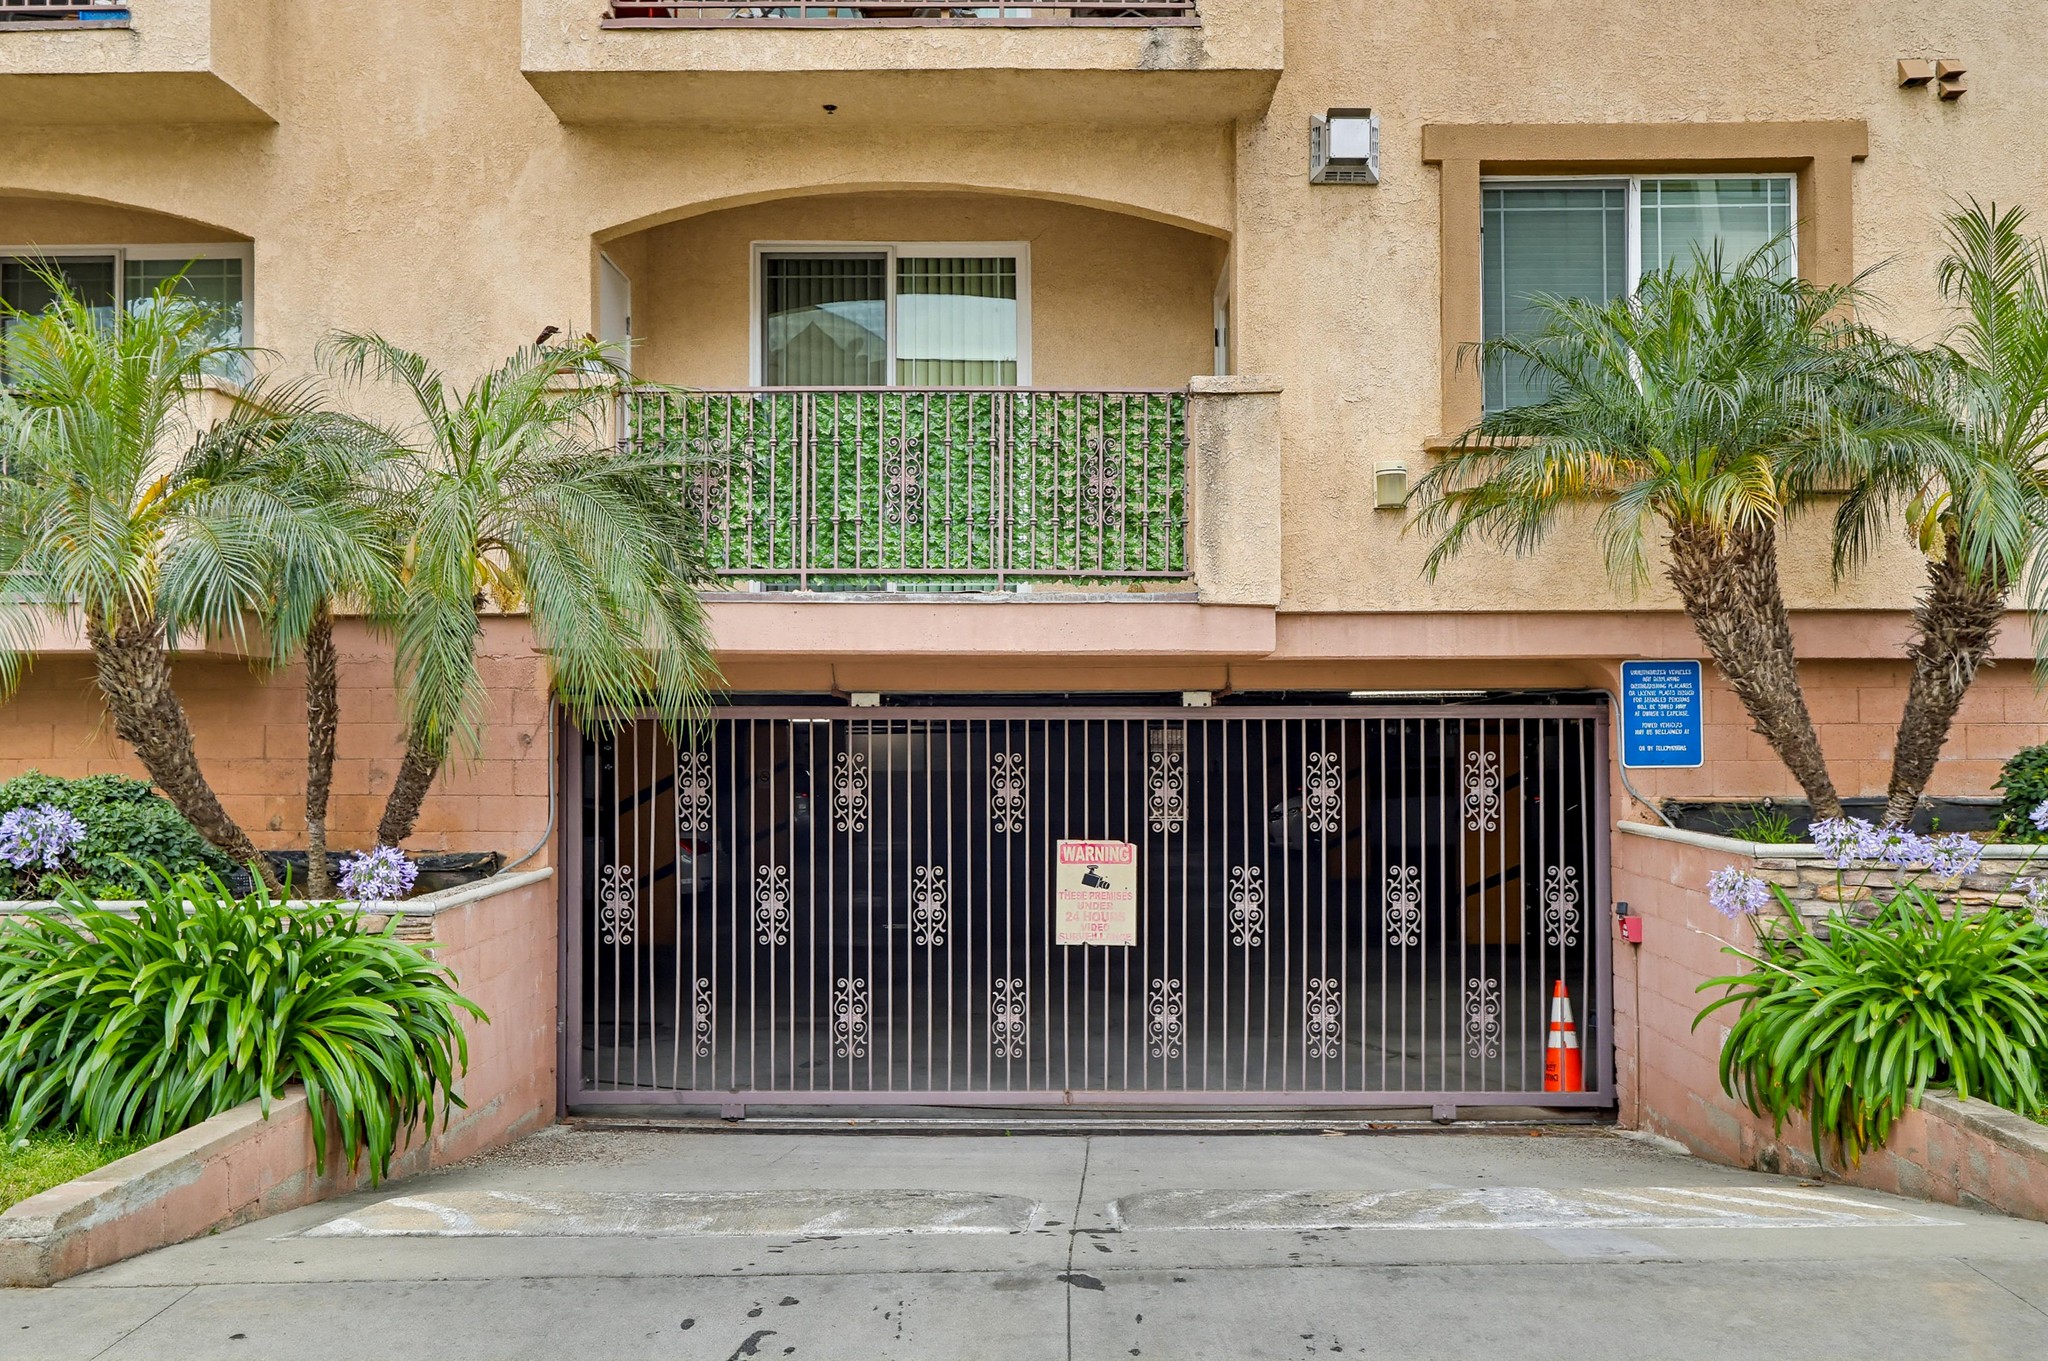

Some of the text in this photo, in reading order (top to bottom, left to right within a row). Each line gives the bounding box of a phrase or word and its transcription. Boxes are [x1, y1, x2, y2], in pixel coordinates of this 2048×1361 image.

[1064, 846, 1129, 861] WARNING
[1059, 892, 1132, 900] THESE PREMISES
[1066, 912, 1079, 922] 24
